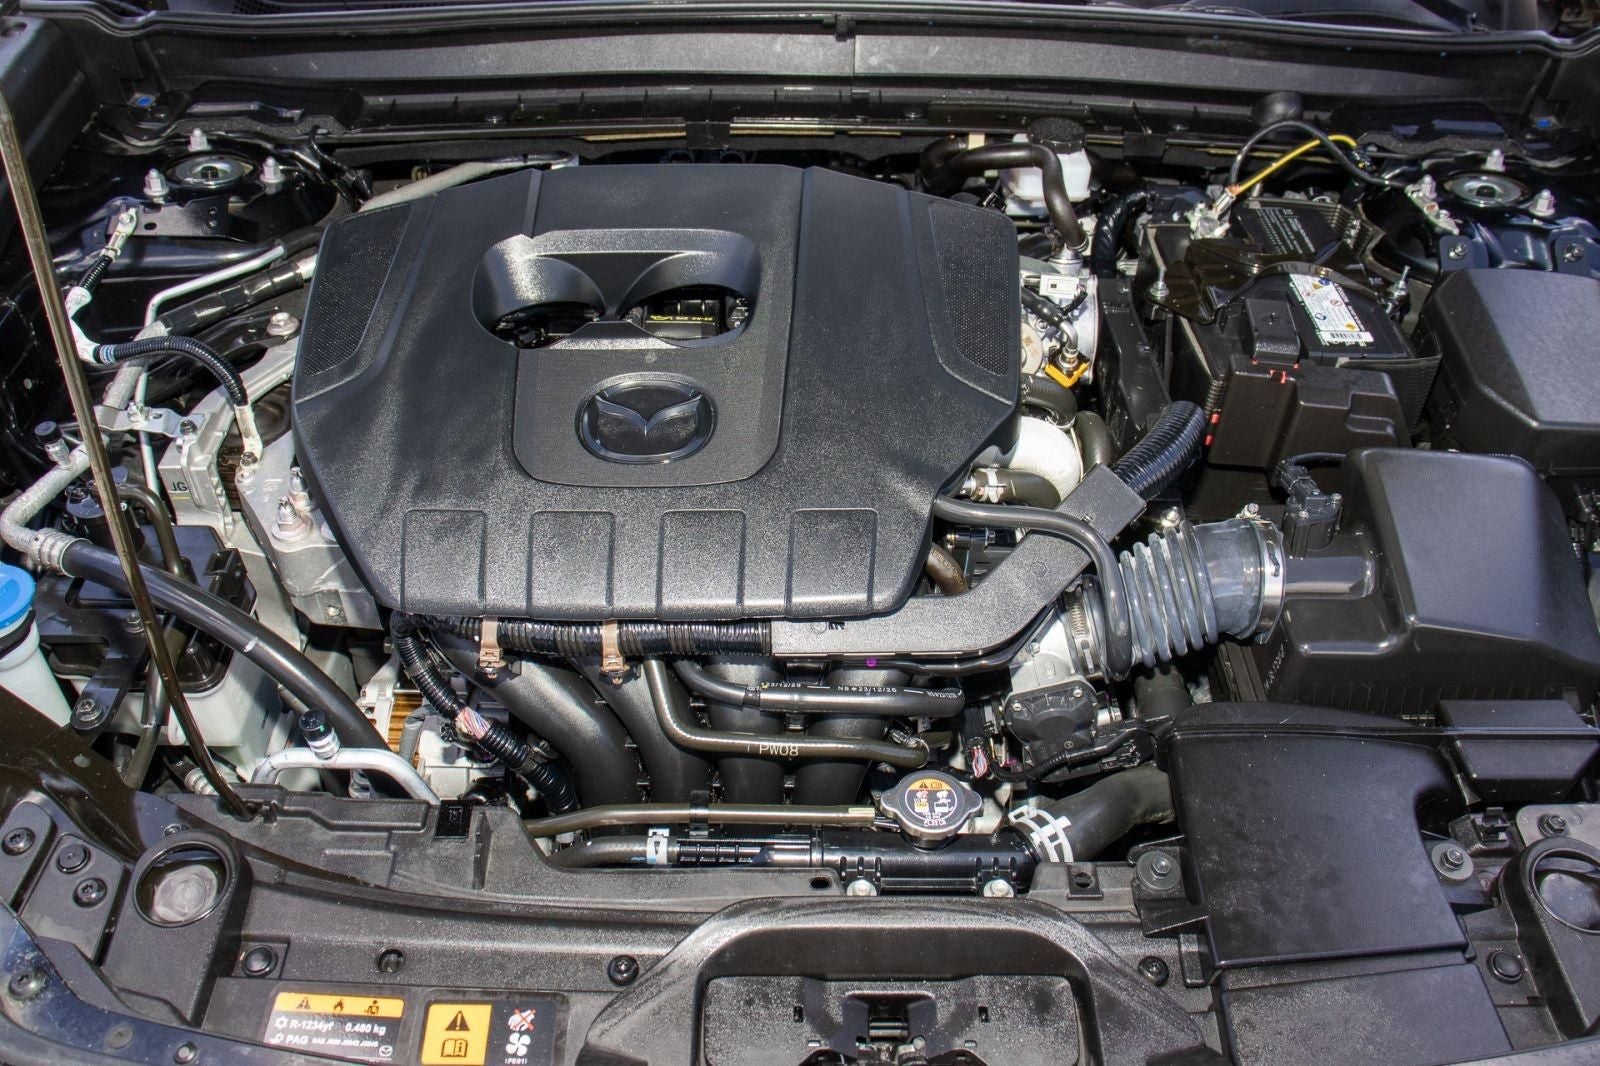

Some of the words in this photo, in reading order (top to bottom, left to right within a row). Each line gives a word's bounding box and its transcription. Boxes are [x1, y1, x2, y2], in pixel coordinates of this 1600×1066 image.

[759, 743, 799, 756] PW08
[289, 1019, 335, 1033] R-1234yf
[373, 1024, 386, 1036] kg
[285, 1034, 309, 1045] PAG
